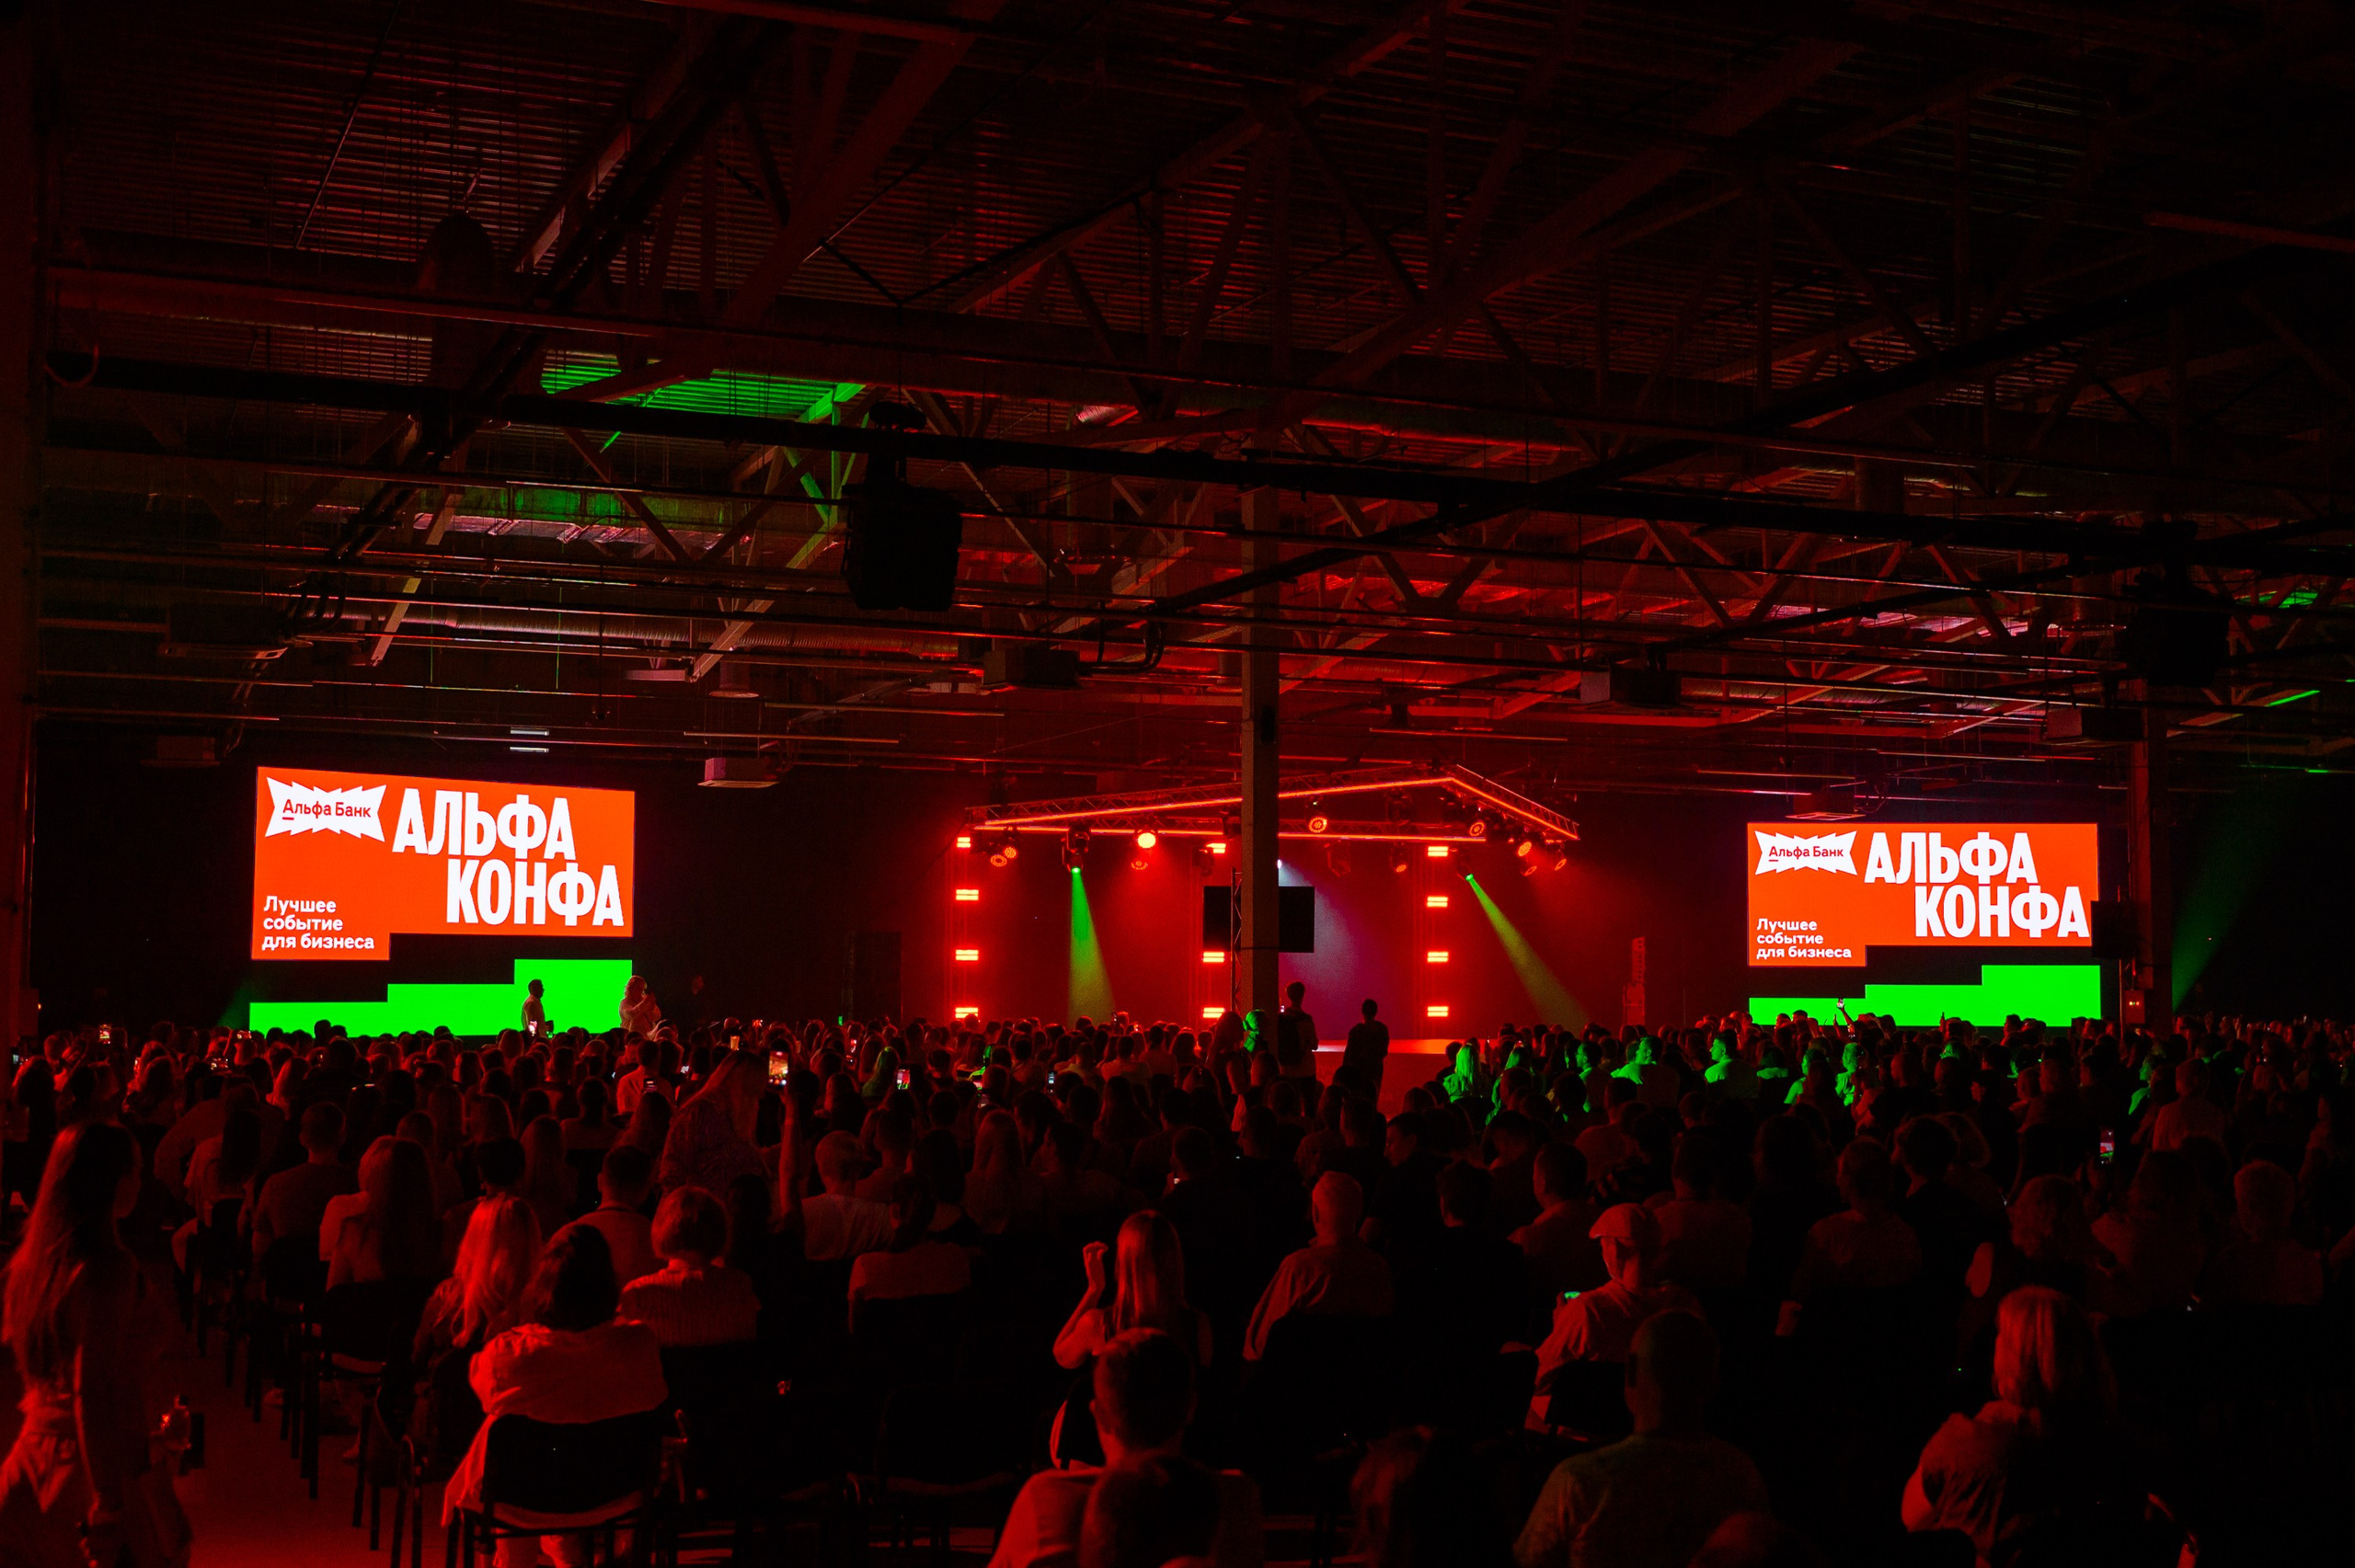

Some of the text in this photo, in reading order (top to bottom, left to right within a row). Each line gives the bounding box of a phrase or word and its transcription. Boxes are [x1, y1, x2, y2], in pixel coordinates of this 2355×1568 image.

[282, 798, 372, 819] Альфа Банк
[392, 787, 577, 861] АЛЬФА
[1768, 845, 1844, 860] Альфа Банк
[1864, 831, 2039, 885] АЛЬФА
[446, 858, 625, 927] КОНФА
[263, 895, 337, 916] Лучшее
[1914, 884, 2090, 938] КОНФА
[263, 913, 343, 932] событие
[1756, 918, 1818, 934] Лучшее
[261, 932, 375, 951] для бизнеса
[1756, 932, 1824, 944] событие
[1756, 944, 1853, 960] для бизнеса
